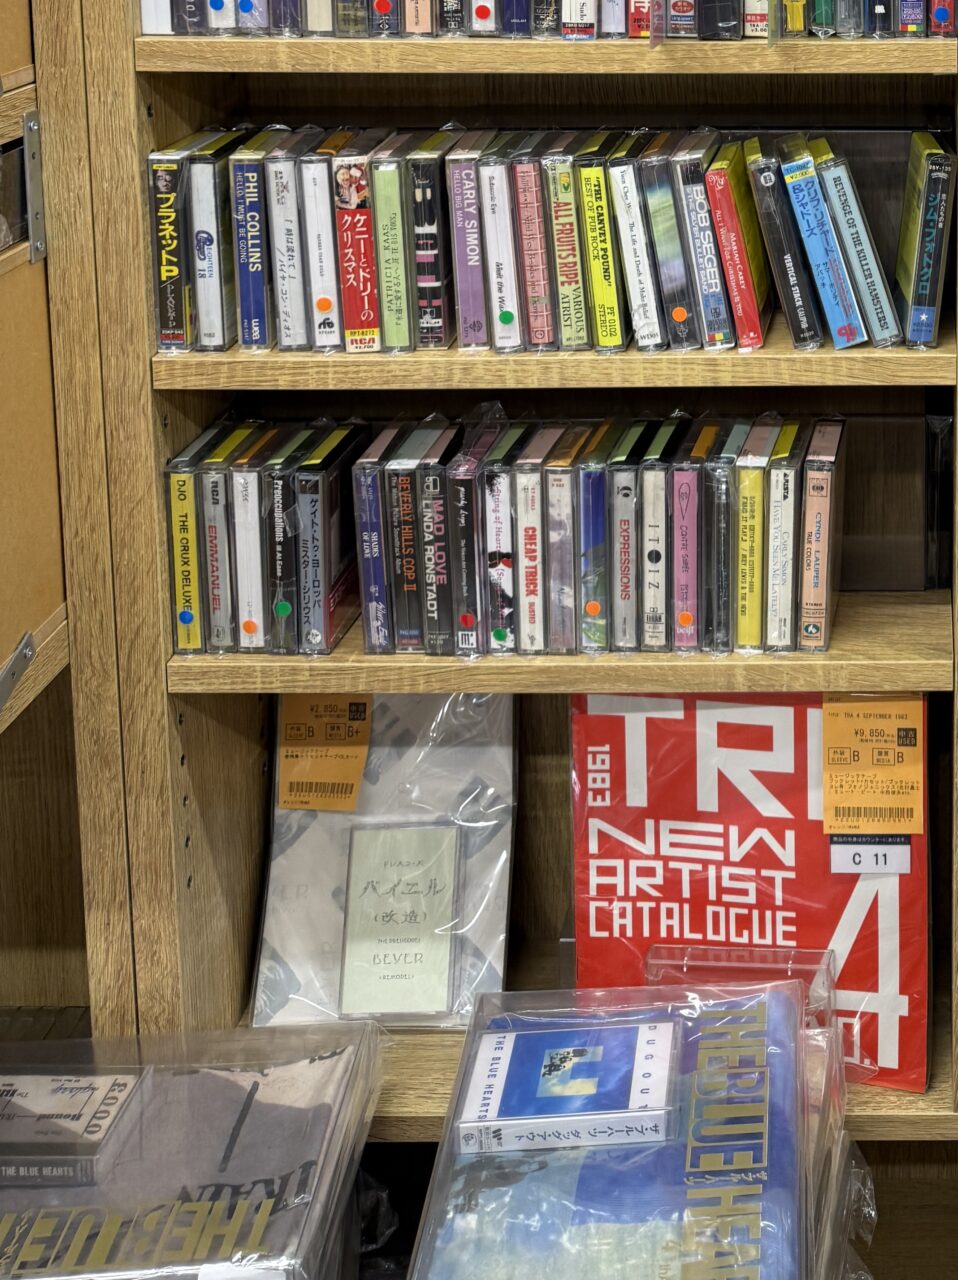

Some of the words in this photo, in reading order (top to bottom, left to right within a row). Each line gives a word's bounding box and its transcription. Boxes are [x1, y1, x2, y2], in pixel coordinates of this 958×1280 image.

[244, 172, 258, 206] PHIL
[462, 170, 477, 214] CARLY
[584, 177, 595, 199] BEST
[693, 185, 712, 227] BOB
[832, 176, 855, 218] REVENGE
[587, 201, 596, 214] OF
[587, 215, 598, 233] PUB
[595, 205, 608, 245] CANVEY
[847, 218, 858, 230] OF
[239, 240, 248, 263] GOING
[246, 212, 262, 272] COLLINS
[341, 215, 357, 288] クリスマス
[383, 224, 391, 250] KAAS
[465, 220, 480, 266] SIMON
[555, 222, 577, 260] FRUITS
[589, 236, 601, 261] ROCK
[850, 230, 862, 249] THE
[354, 213, 374, 321] ケニーとドリーの
[558, 262, 580, 287] RIPE
[700, 232, 721, 293] SEGER
[783, 254, 797, 285] VERTICAL
[791, 287, 802, 306] STACK
[855, 249, 873, 280] KILLER
[384, 258, 394, 311] PATRICIA
[561, 293, 573, 329] ATRIST
[571, 287, 584, 334] VARIOUS
[597, 304, 608, 337] STEREO
[866, 281, 890, 332] HAMSTERS!
[251, 319, 262, 340] wea
[176, 479, 186, 501] DJO
[398, 477, 412, 522] BEVERLY
[179, 513, 188, 534] THE
[273, 480, 285, 542] Preoccupations
[422, 500, 435, 542] LINDA
[431, 500, 444, 535] MAD
[814, 512, 822, 543] CYNDI
[180, 537, 190, 567] CRUX
[363, 542, 371, 559] LOVE
[371, 532, 379, 558] SHADES
[401, 525, 413, 554] HILLS
[524, 527, 537, 562] CHEAP
[207, 525, 221, 615] EMMANUEL
[403, 558, 415, 580] COP
[434, 543, 448, 585] LOVE
[619, 519, 631, 600] EXPRESSIONS
[805, 547, 813, 571] COLORS
[812, 550, 820, 588] LAUPER
[181, 570, 192, 611] DELUXE
[423, 545, 438, 620] RONSTADT
[525, 565, 538, 597] TRICK
[528, 602, 536, 624] BUSTED
[853, 751, 860, 762] B
[897, 752, 904, 763] B
[587, 744, 611, 807] 1983
[588, 818, 795, 867] NEW
[852, 853, 861, 865] C
[874, 853, 888, 865] 11
[589, 859, 796, 906] ARTIST
[589, 901, 797, 947] CATALOGUE
[814, 873, 909, 1070] 4
[487, 1055, 502, 1091] BLUE
[477, 1085, 494, 1121] HEARTS
[19, 1167, 40, 1178] BLUE
[42, 1167, 74, 1178] HEARTS
